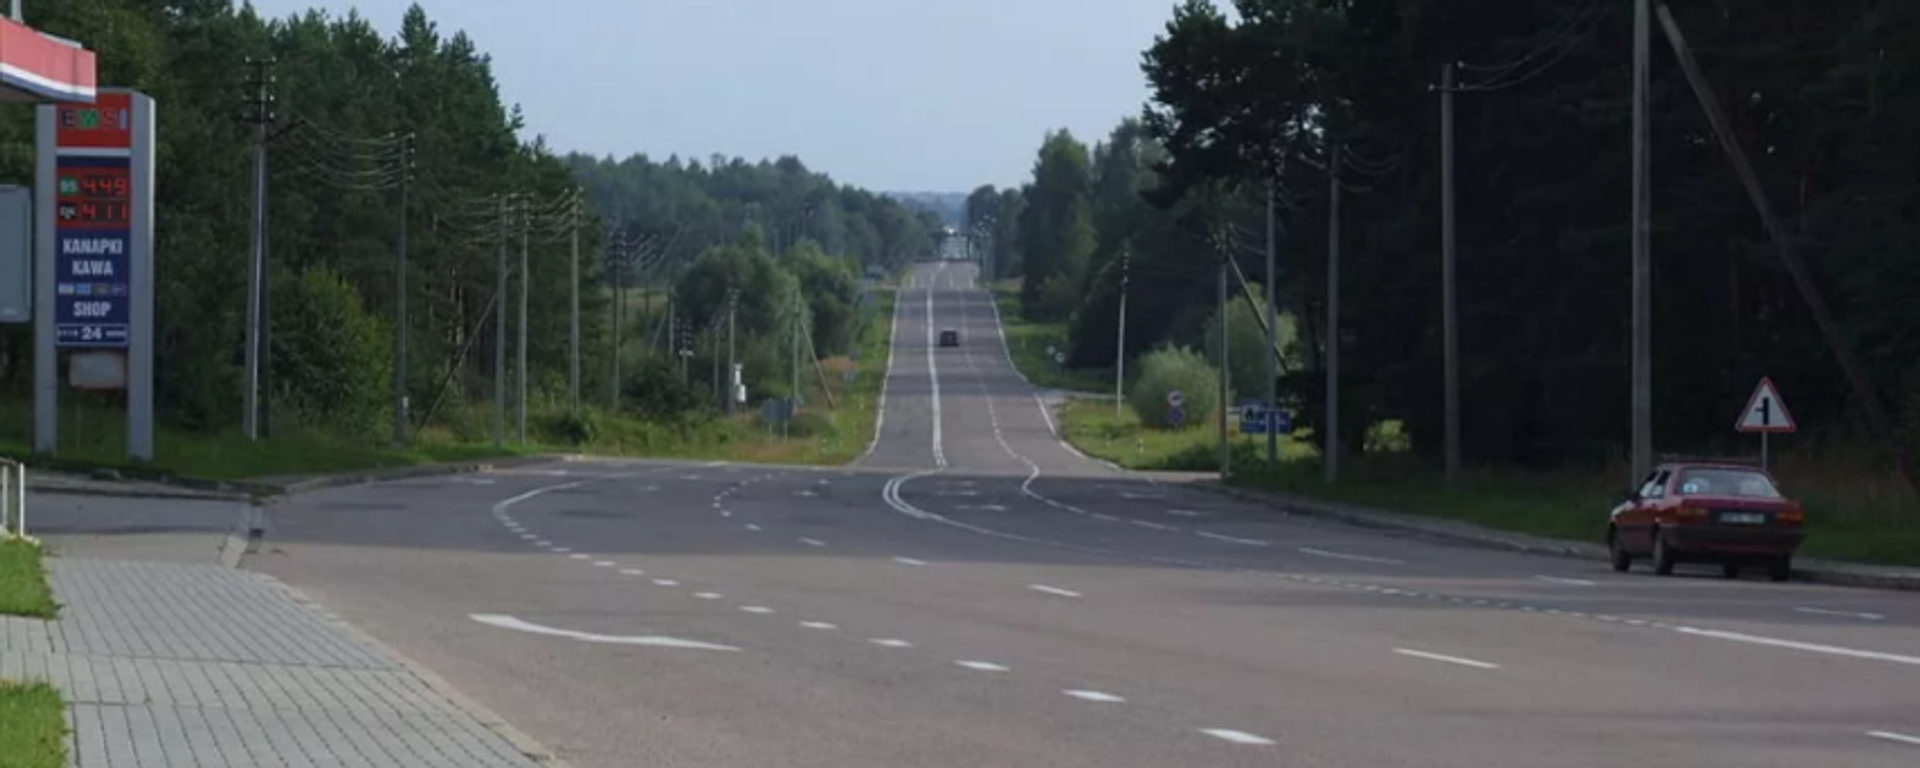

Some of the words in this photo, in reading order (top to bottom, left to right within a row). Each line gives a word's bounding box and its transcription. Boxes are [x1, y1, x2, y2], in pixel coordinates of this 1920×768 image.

[62, 238, 122, 255] KANAPKI
[72, 260, 113, 275] KAWA
[73, 301, 111, 317] SHOP
[81, 326, 102, 340] 24
